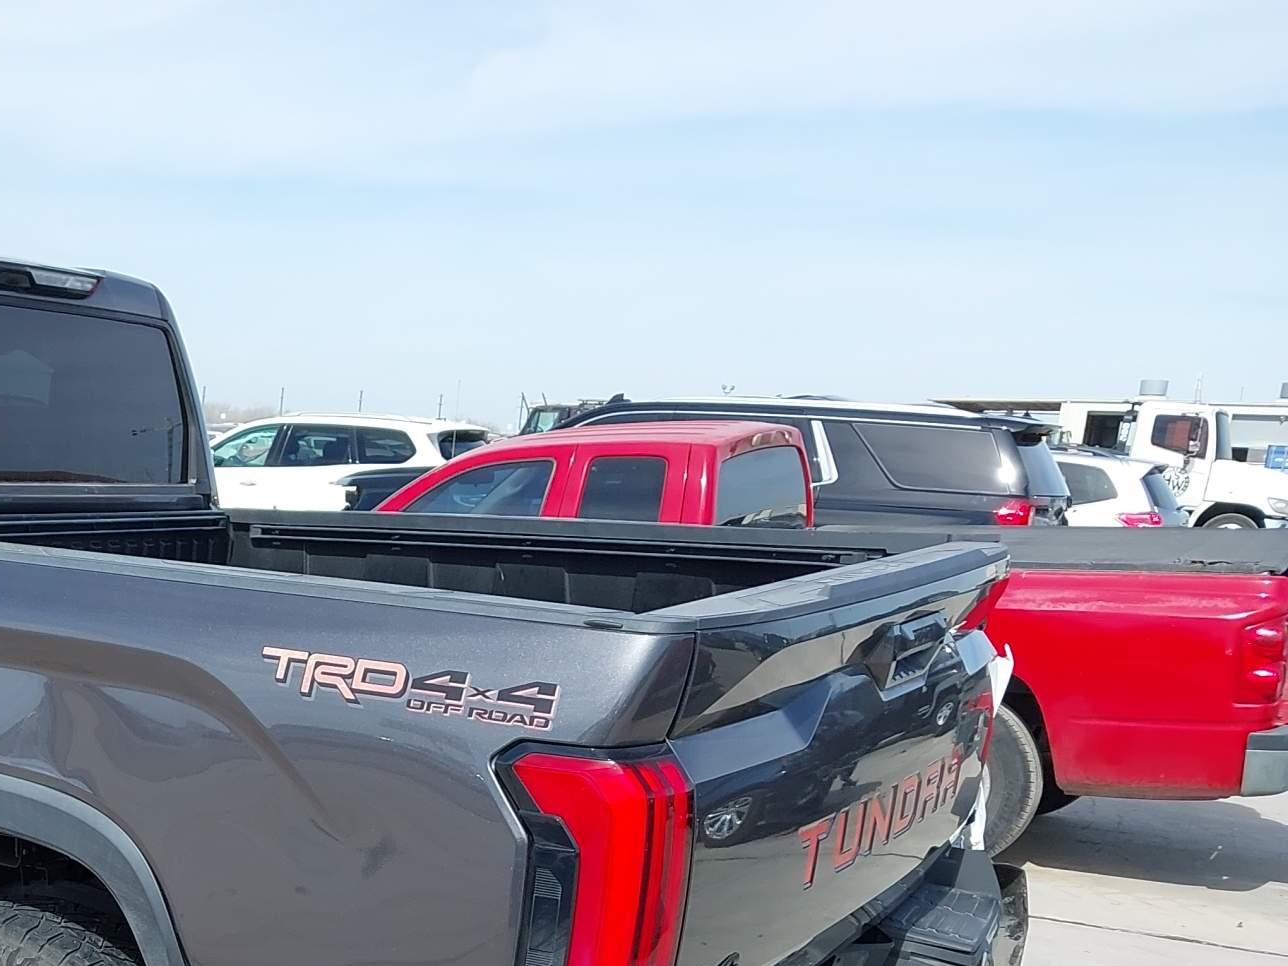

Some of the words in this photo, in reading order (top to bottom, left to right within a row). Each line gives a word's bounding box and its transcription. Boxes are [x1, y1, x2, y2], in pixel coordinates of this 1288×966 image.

[262, 646, 411, 705] TRD
[410, 669, 561, 716] 4x4
[406, 699, 463, 716] OFF
[466, 706, 553, 732] ROAD
[798, 756, 962, 891] TUNDRA
